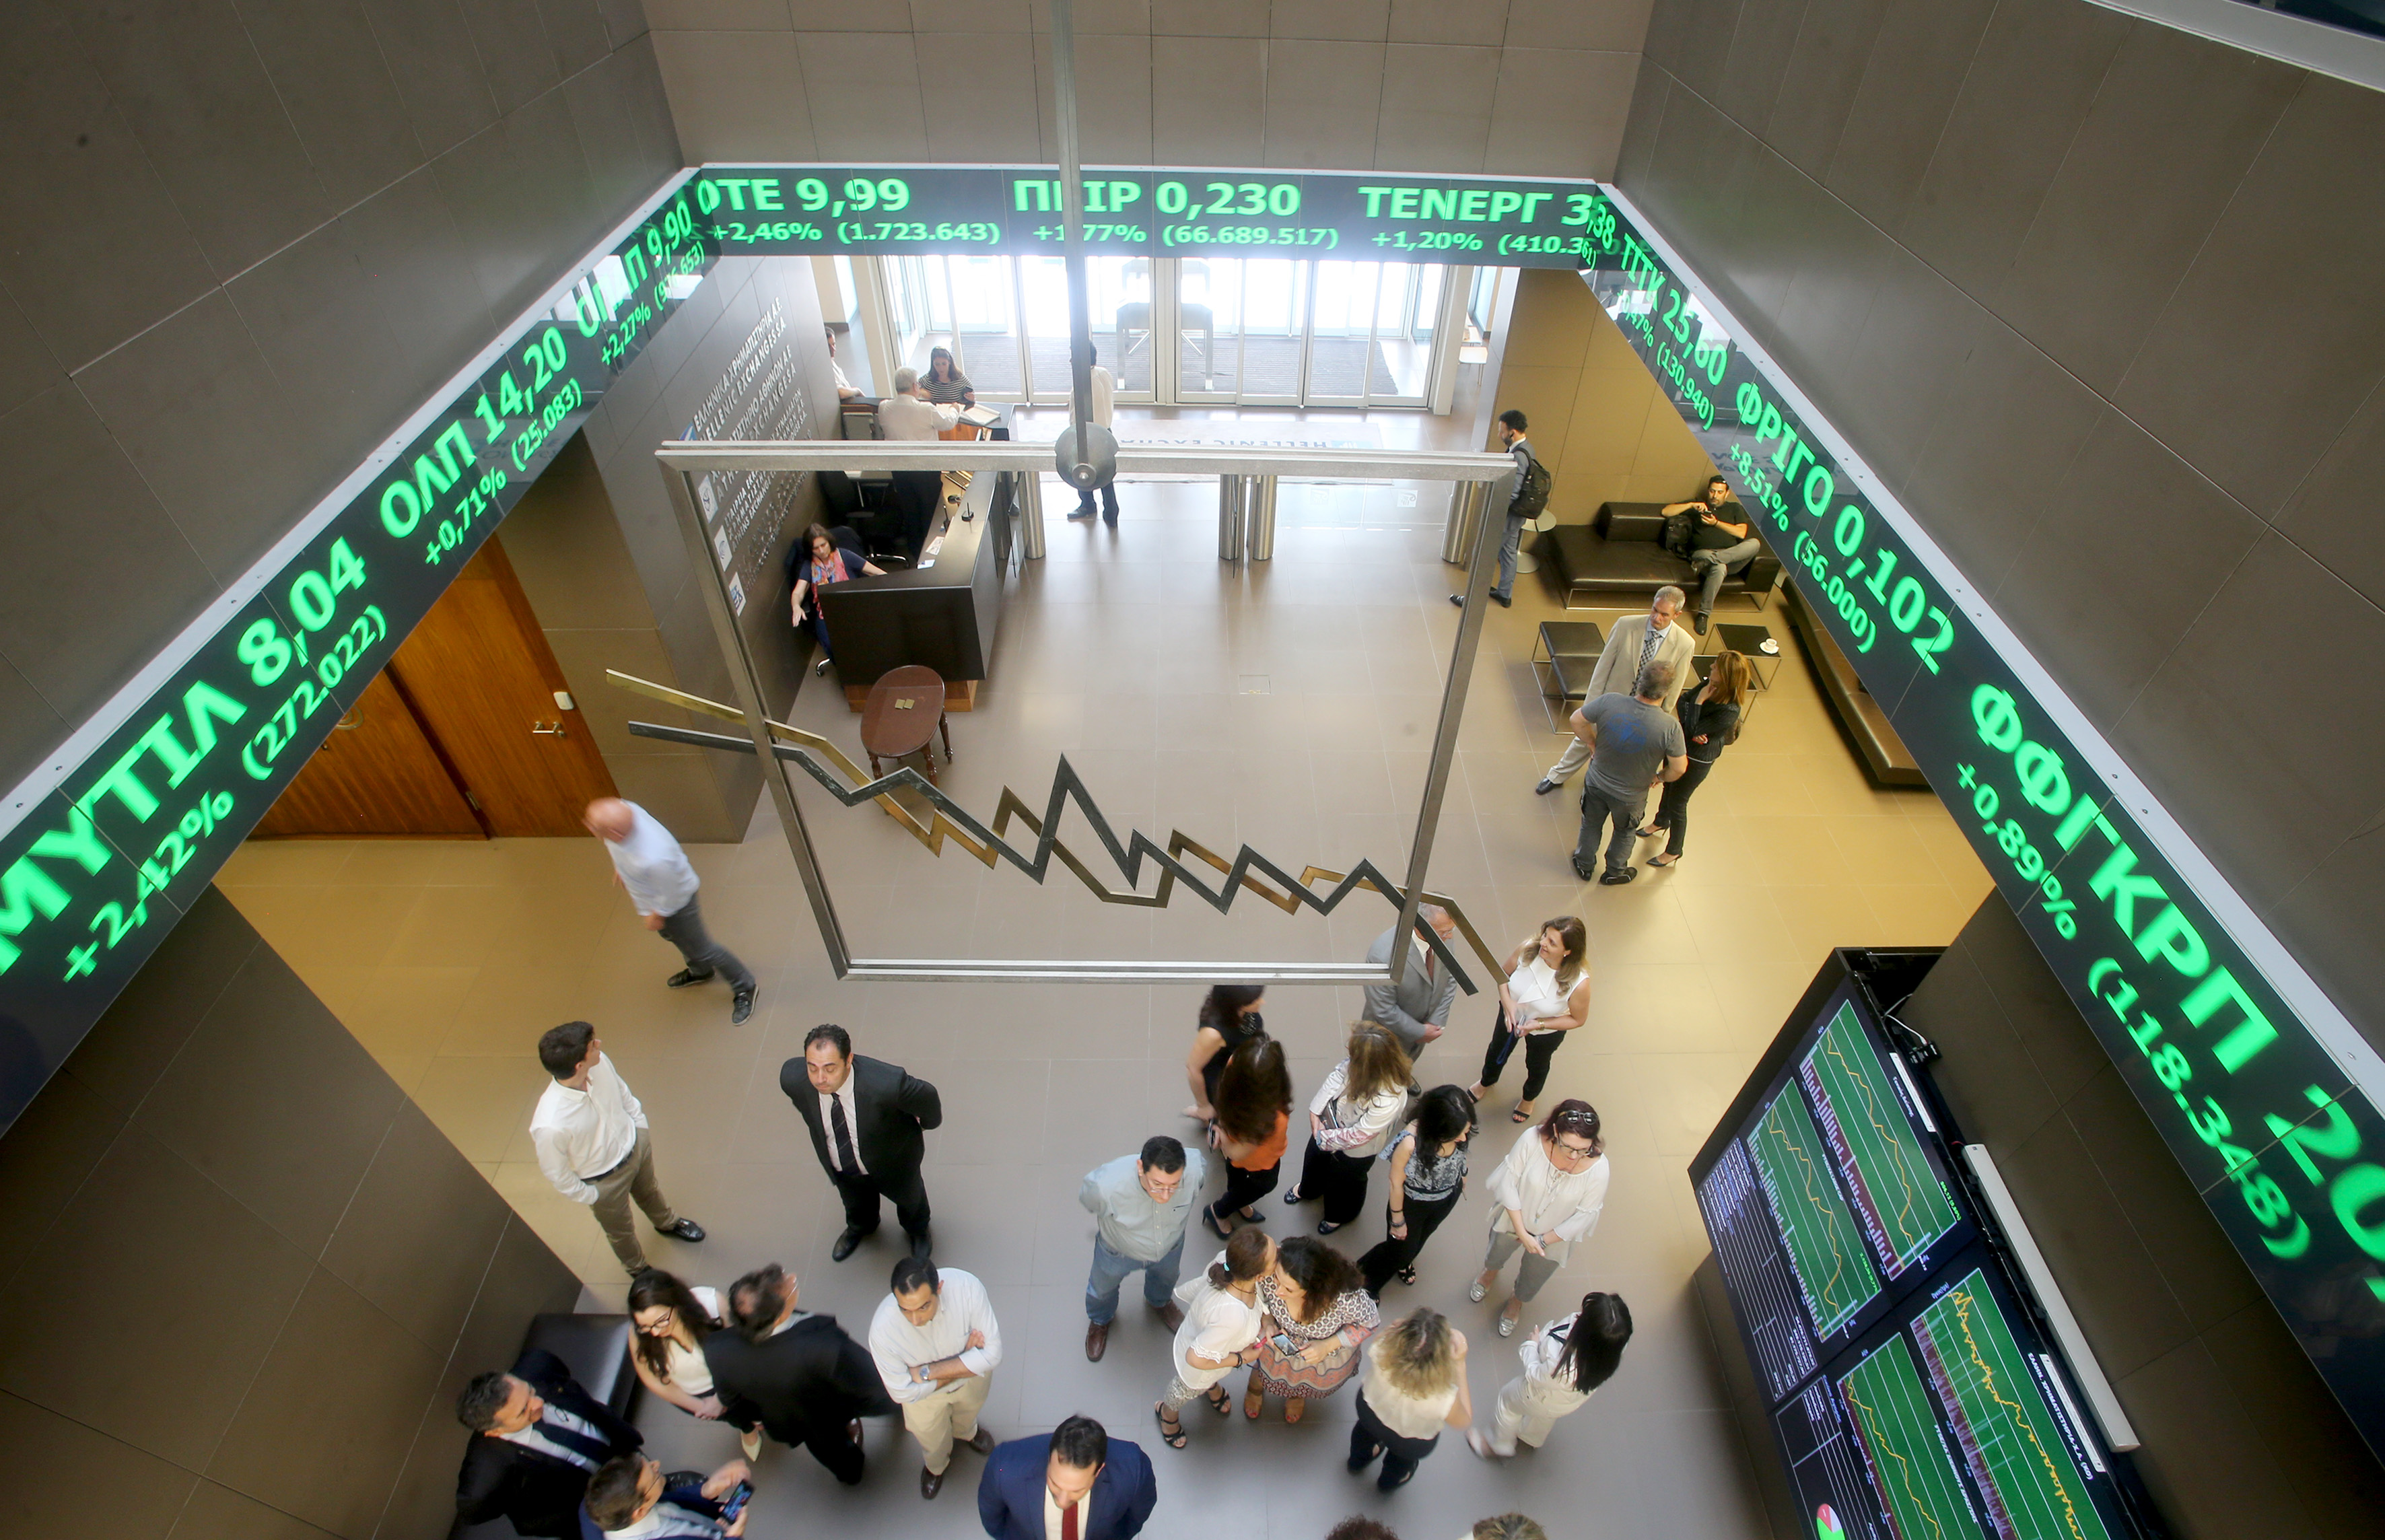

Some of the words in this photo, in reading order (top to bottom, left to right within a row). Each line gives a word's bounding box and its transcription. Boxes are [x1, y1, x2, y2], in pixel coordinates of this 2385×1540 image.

[646, 200, 693, 269] 9,90
[714, 221, 823, 244] +2,46%
[837, 221, 1001, 245] (1.723.643)
[1033, 223, 1147, 243] +177%
[1162, 224, 1340, 250] (66.689.517)
[1371, 230, 1484, 252] +1,20%
[1497, 232, 1597, 271] (410.361)
[795, 177, 910, 218] 9,99
[1155, 181, 1301, 221] 0,230
[1357, 185, 1554, 224] ΤΕΝΕΡΓ
[1561, 193, 1616, 250] 3,38
[601, 302, 652, 365] +2,27%
[693, 374, 730, 432] ΕΛΛΗΝΙΚΑ
[727, 310, 772, 380] ΧΡΗΜΑΤΙΣΤΗΡΙΑ
[736, 329, 777, 397] EXCHANGES
[759, 357, 784, 403] ΑΘΗΝΩΝ
[1656, 341, 1715, 431] (130.940)
[1661, 288, 1728, 386] 25,60
[380, 420, 477, 538] ΟΛΠ
[475, 327, 567, 445] 14,20
[425, 466, 508, 565] +0,71%
[511, 378, 583, 472] (25.083)
[1729, 442, 1791, 532] +8,51%
[1793, 530, 1877, 654] (56.000)
[1736, 382, 1834, 518] ΦΡΙΓΟ
[1834, 504, 1955, 676] 0,102
[236, 536, 367, 687] 8,04
[63, 790, 234, 983] +2,42%
[242, 604, 388, 781] (272.022)
[1970, 682, 2279, 1076] ΦΦΓΚΡΠ
[1956, 761, 2077, 941] +0,89%
[2087, 957, 2311, 1259] (118.348)
